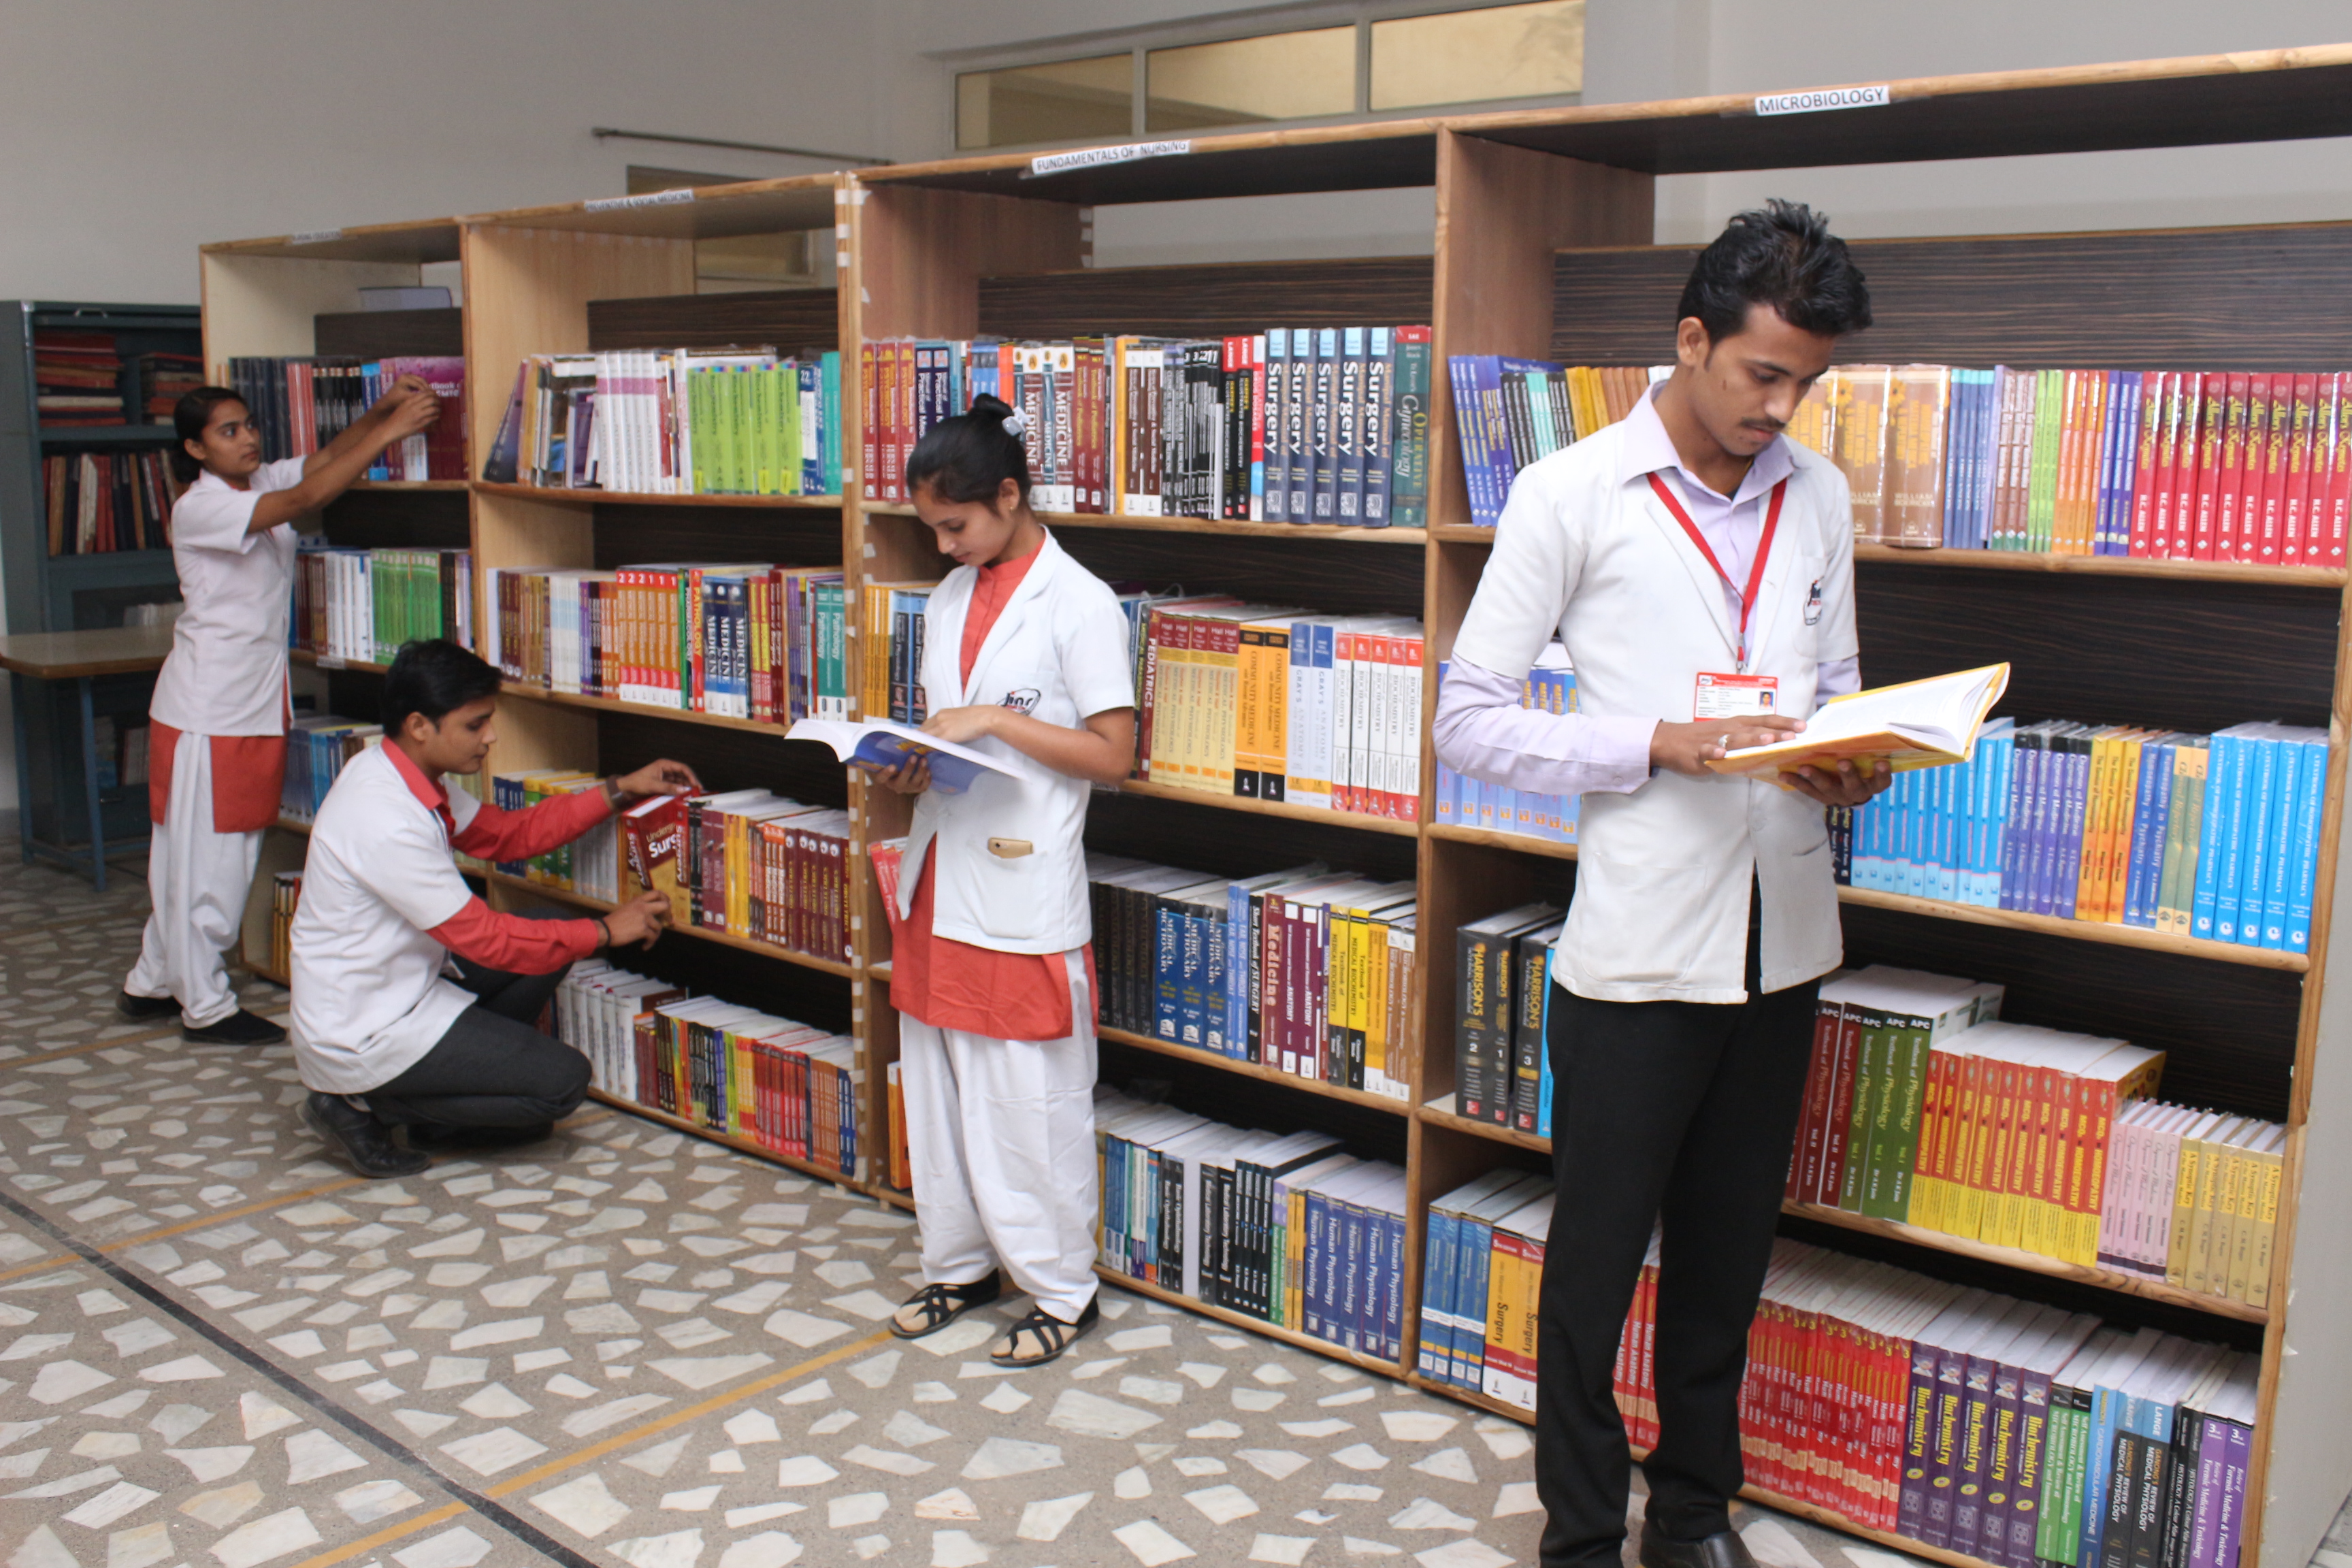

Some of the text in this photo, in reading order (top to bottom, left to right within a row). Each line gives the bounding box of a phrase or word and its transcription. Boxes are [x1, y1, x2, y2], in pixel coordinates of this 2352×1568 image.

[1759, 88, 1884, 112] MICROBIOLOGY
[1036, 140, 1186, 170] FUNDAMENTALS OF NURSING
[918, 372, 927, 413] Practical
[934, 372, 943, 413] Practical
[1264, 362, 1281, 454] Surgery
[1289, 362, 1306, 455] Surgery
[1314, 362, 1332, 456] Surgery
[1338, 361, 1358, 456] Surgery
[1365, 361, 1384, 457] Surgery
[1382, 363, 1392, 458] Manipal Manual of
[1026, 391, 1036, 466] MEDICINE
[1044, 420, 1052, 468] MEDICINE
[1056, 391, 1067, 466] MEDICINE
[1395, 395, 1419, 478] Gynecology
[1413, 412, 1428, 489] OPERATIVE
[2287, 515, 2296, 538] ALLEN
[2310, 515, 2320, 538] ALLEN
[817, 612, 826, 659] Pathology
[832, 612, 841, 659] Pathology
[1144, 638, 1156, 708] PEDIATRICS
[1247, 651, 1258, 747] COMMUNITY MEDICINE
[2049, 800, 2060, 834] Medicine
[2152, 825, 2165, 868] Psychiatry
[2276, 856, 2285, 893] PHARMACY
[1238, 970, 1246, 998] THROAT
[1251, 961, 1258, 970] of
[1267, 924, 1280, 1006] Medicine
[1472, 950, 1486, 1016] HARRISON'S
[1286, 986, 1294, 1022] ANATOMY
[1304, 990, 1312, 1027] ANATOMY
[1529, 962, 1543, 1029] HARRISON'S
[1821, 1008, 1840, 1018] APC
[1844, 1013, 1862, 1023] APC
[1886, 1017, 1906, 1028] APC
[1910, 1019, 1931, 1030] APC
[1469, 1043, 1478, 1052] 2
[1498, 1049, 1503, 1058] 1
[1524, 1056, 1532, 1065] 3
[1886, 1035, 1897, 1065] Textbook
[1910, 1037, 1922, 1067] Textbook
[1876, 1077, 1894, 1130] Physiology
[1900, 1079, 1918, 1132] Physiology
[2089, 1149, 2103, 1210] HOMOEOPATHY
[2267, 1175, 2278, 1205] Synoptic
[1222, 1207, 1230, 1238] Laboratory
[2266, 1207, 2275, 1220] Key
[1221, 1239, 1230, 1272] Technology
[1307, 1209, 1319, 1298] Human Physiology
[1324, 1218, 1337, 1306] Human Physiology
[1344, 1224, 1358, 1315] Human Physiology
[1365, 1227, 1379, 1318] Human Physiology
[1387, 1234, 1401, 1324] Human Physiology
[1493, 1303, 1509, 1343] Surgery
[1522, 1313, 1539, 1354] Surgery
[1627, 1320, 1642, 1386] Human Anatomy
[1639, 1323, 1654, 1389] Human Anatomy
[1909, 1386, 1931, 1457] Biochemistry
[1936, 1394, 1959, 1465] Biochemistry
[2125, 1396, 2137, 1428] LANGE
[2152, 1406, 2163, 1436] LANGE
[1963, 1401, 1987, 1473] Biochemistry
[1991, 1409, 2014, 1481] Biochemistry
[2019, 1416, 2043, 1488] Biochemistry
[2087, 1428, 2105, 1535] CARDIOVASCULAR MEDICINE
[2138, 1446, 2154, 1531] MEDICAL PHYSIOLOGY
[2147, 1448, 2161, 1524] GANONG'S REVIEW OF
[2224, 1465, 2236, 1492] Forensic
[2221, 1494, 2234, 1523] Medicine
[2215, 1531, 2230, 1567] Toxicology
